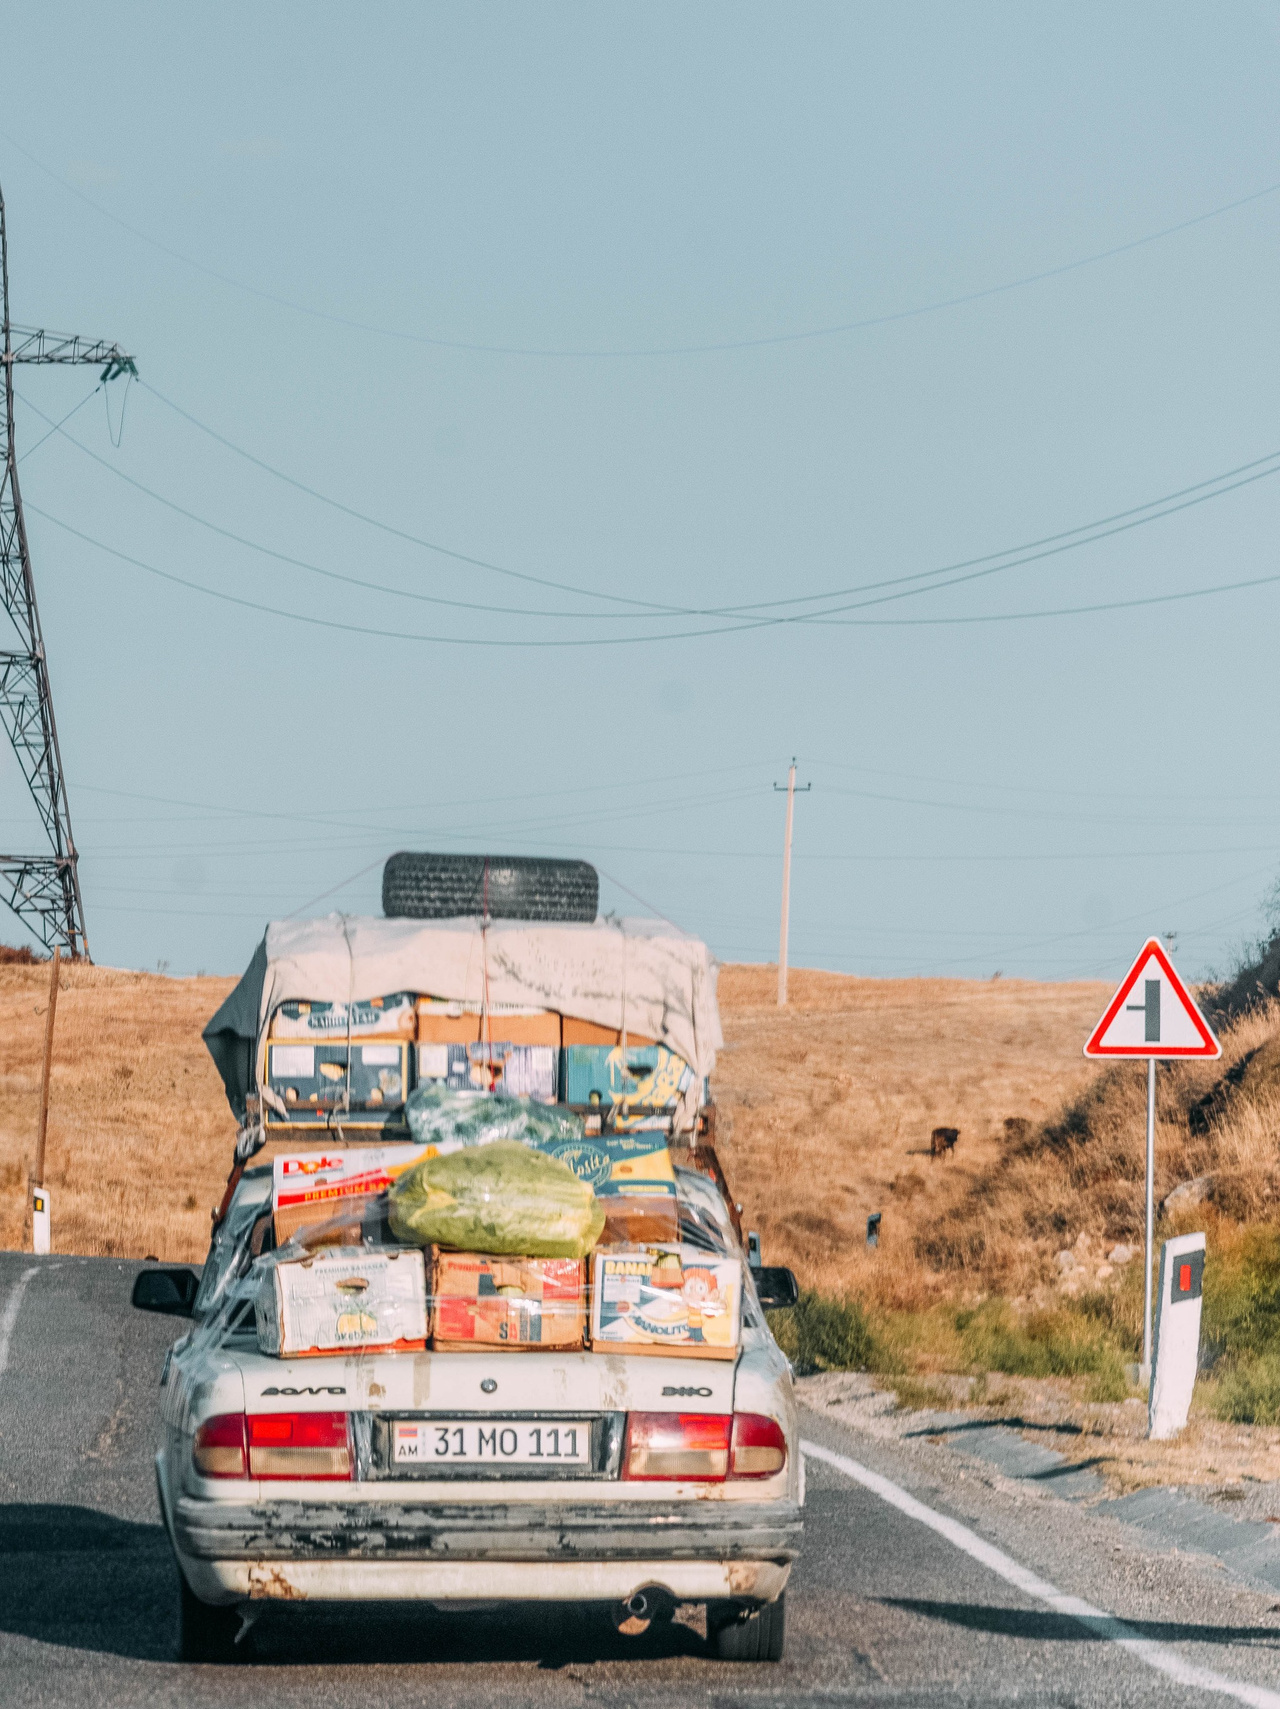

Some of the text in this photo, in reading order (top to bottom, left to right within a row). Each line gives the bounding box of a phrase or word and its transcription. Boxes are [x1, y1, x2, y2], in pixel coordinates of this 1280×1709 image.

[283, 1155, 344, 1175] Dole
[305, 1184, 365, 1201] PREMIUM
[398, 1444, 419, 1457] AM
[434, 1427, 580, 1457] 31 MO 111
